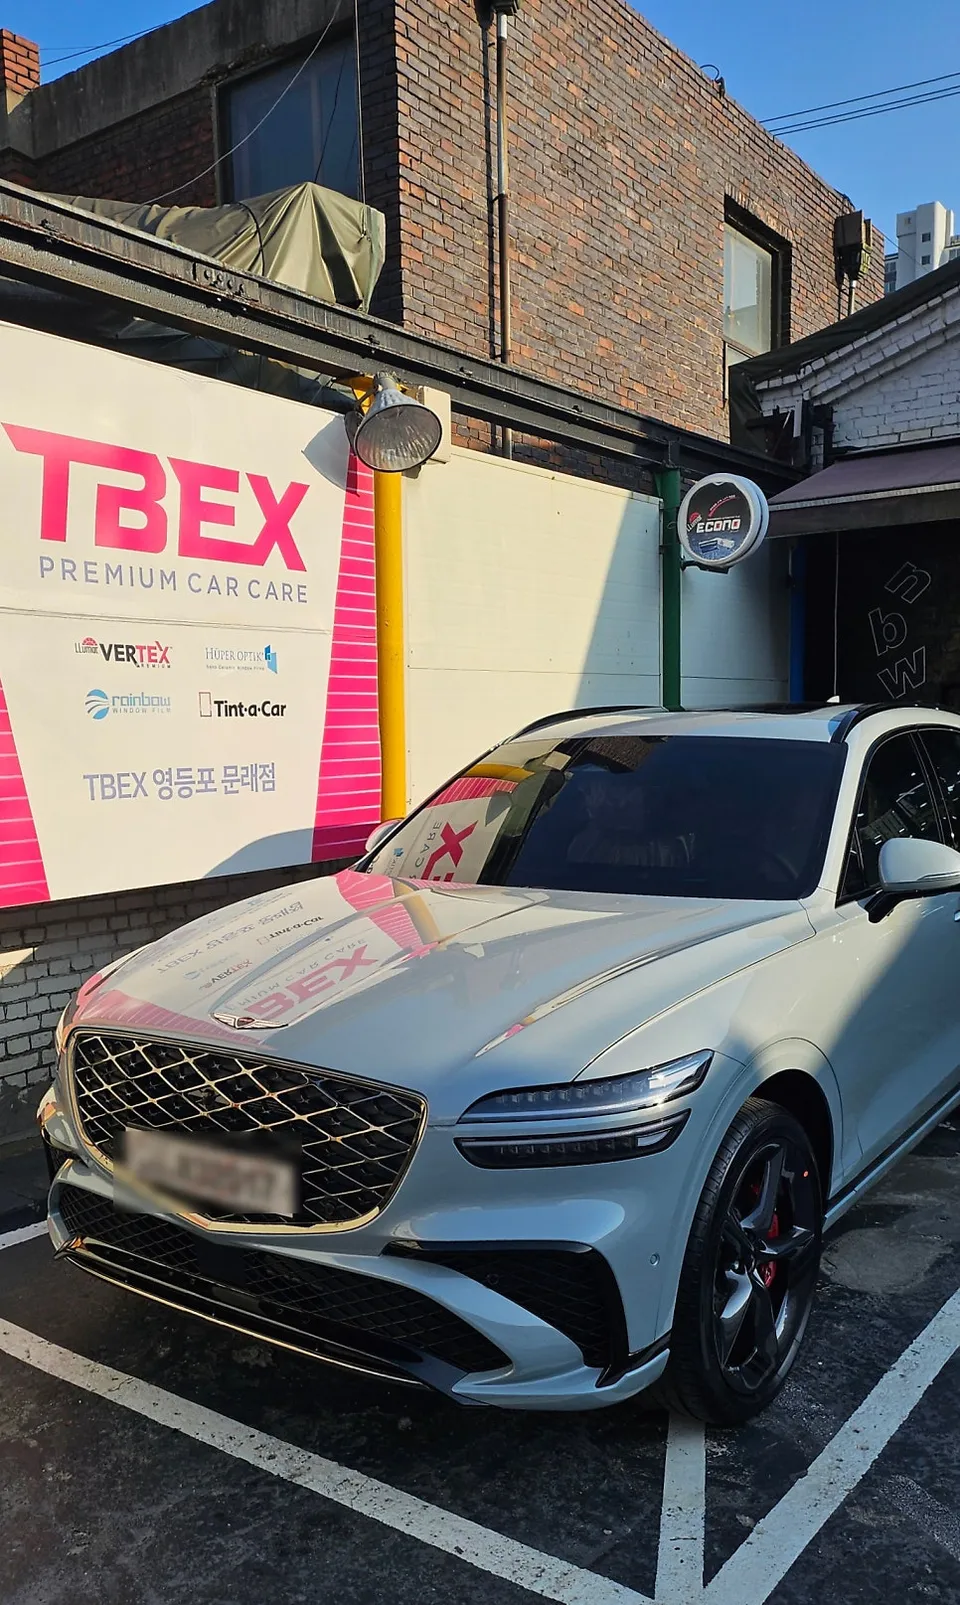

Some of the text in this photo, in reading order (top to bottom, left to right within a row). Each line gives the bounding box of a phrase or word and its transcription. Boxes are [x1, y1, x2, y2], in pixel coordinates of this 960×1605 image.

[1, 422, 310, 572] TBEX
[39, 556, 308, 604] PREMIUM CAR CARE
[99, 640, 170, 667] VERTEX
[236, 651, 262, 662] OPTIK
[112, 692, 171, 707] rainbow
[83, 762, 276, 801] TBEX 영등포 문래점
